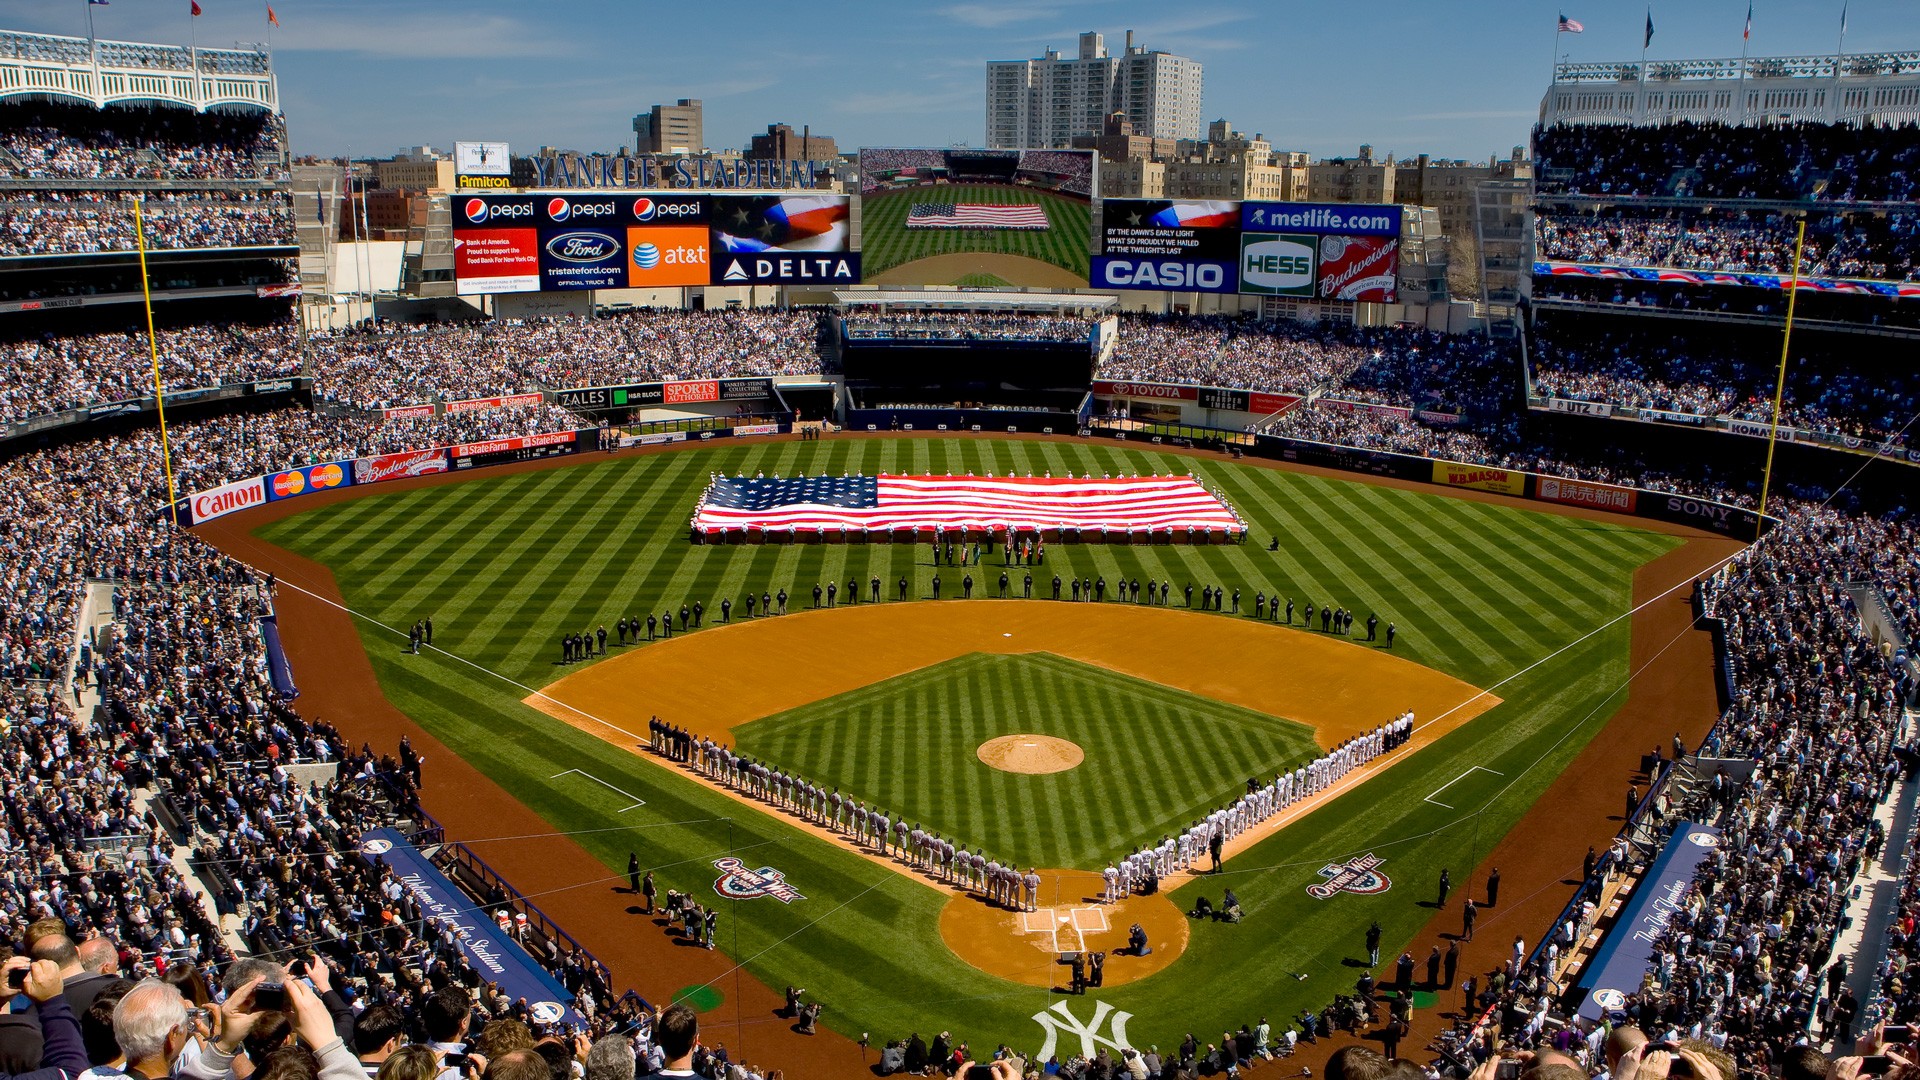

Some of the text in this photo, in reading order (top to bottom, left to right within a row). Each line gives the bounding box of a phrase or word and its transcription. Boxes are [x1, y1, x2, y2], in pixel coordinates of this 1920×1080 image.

[460, 175, 510, 188] Armitron
[531, 156, 816, 189] YANKEE STADIUM
[490, 202, 534, 218] pepsi
[572, 201, 616, 218] pepsi
[657, 201, 701, 217] pepsi
[1271, 208, 1390, 230] metlife.com
[564, 238, 604, 256] Ford
[664, 245, 706, 264] at&t
[548, 266, 620, 276] tristateford.com
[756, 259, 852, 278] DELTA
[1247, 254, 1310, 275] HESS
[1318, 238, 1398, 298] Budweiser
[1105, 260, 1224, 289] CASIO
[1347, 281, 1374, 295] American
[563, 391, 604, 406] ZALES
[668, 383, 715, 395] SPORTS
[1132, 385, 1180, 397] TOYOTA
[1206, 395, 1242, 404] SHARPER
[1567, 401, 1590, 413] UTZ
[365, 450, 434, 483] Budweiser
[312, 473, 343, 482] MasterCard
[195, 484, 262, 518] Canon
[1561, 483, 1629, 508] 読売新聞
[1668, 498, 1731, 521] SONY
[718, 860, 800, 900] OPENING WEEK
[1310, 856, 1378, 896] OPENING WEEK
[1633, 880, 1686, 943] New York Yankees
[400, 873, 436, 905] Welcome
[429, 903, 446, 912] to
[465, 940, 505, 974] Stadium
